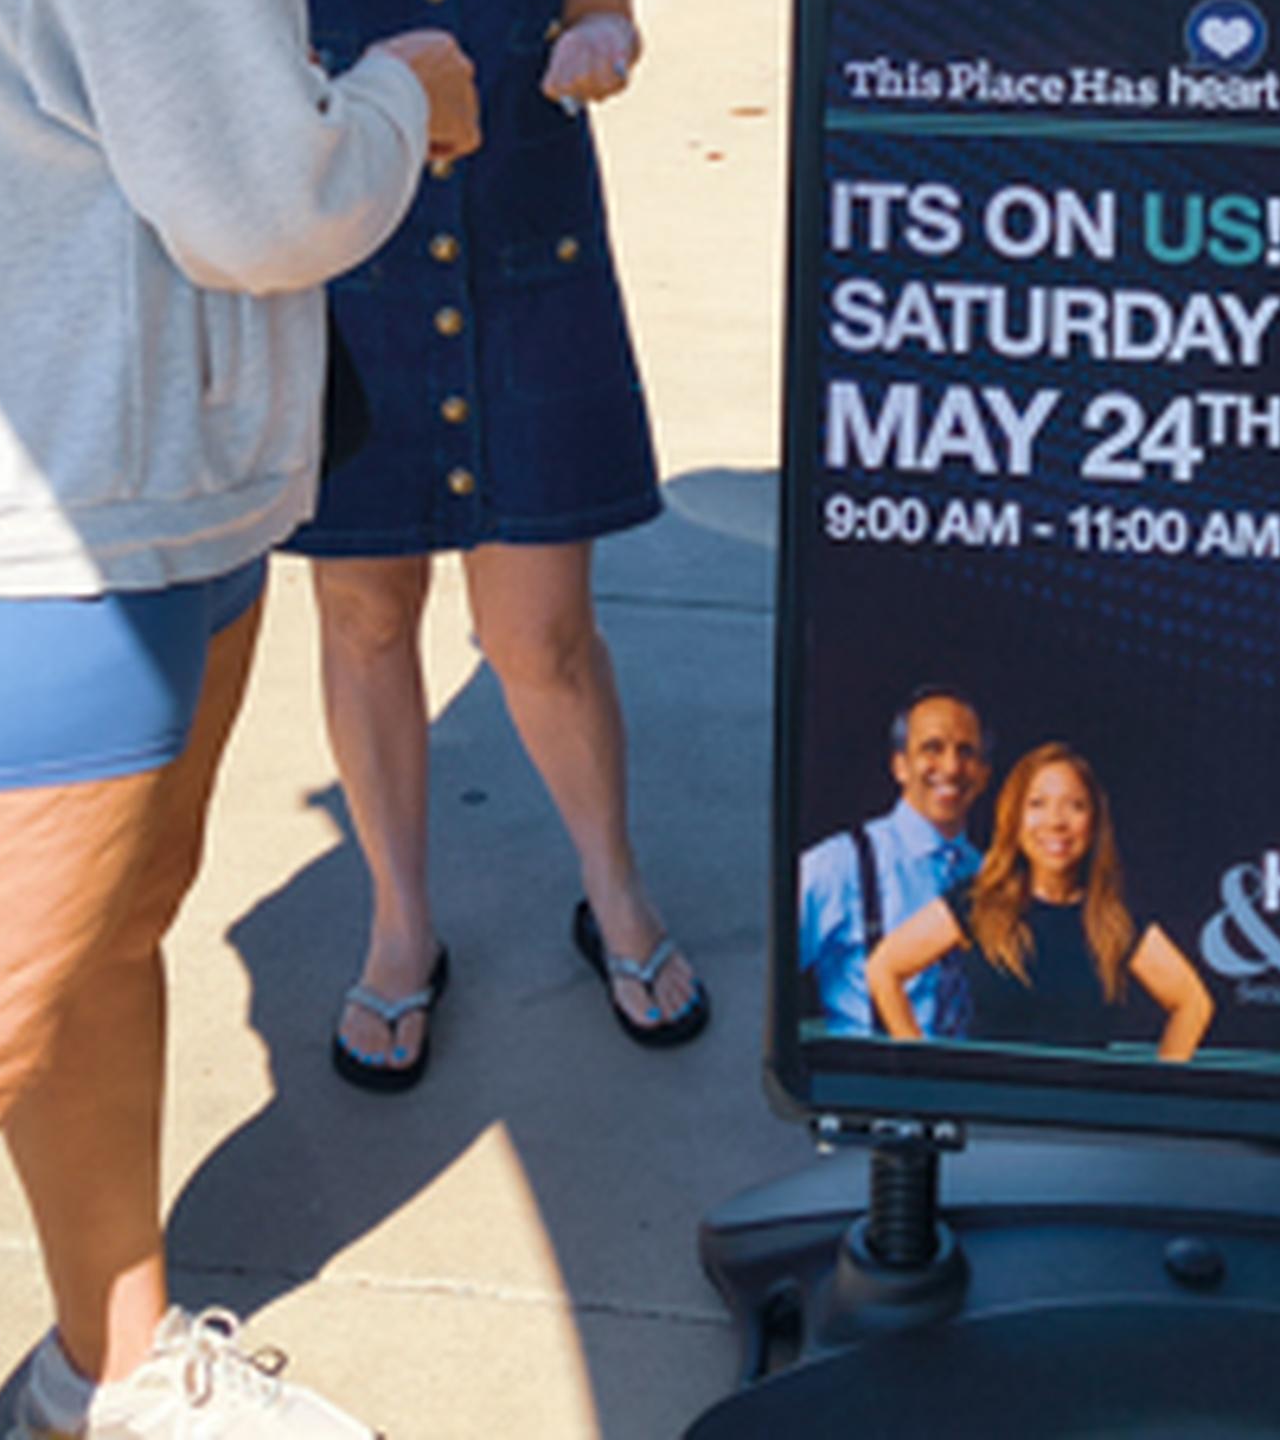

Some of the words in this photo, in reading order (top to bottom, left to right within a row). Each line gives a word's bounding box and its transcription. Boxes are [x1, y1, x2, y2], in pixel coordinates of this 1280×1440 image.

[845, 57, 941, 100] This
[947, 59, 1065, 105] Place
[1070, 68, 1158, 107] Has
[1169, 67, 1280, 110] heart
[831, 182, 963, 255] ITS
[983, 185, 1115, 259] ON
[825, 381, 1061, 475] MAY
[824, 493, 928, 542] 9:00
[936, 498, 1020, 546] AM
[1068, 505, 1188, 553] 11:00
